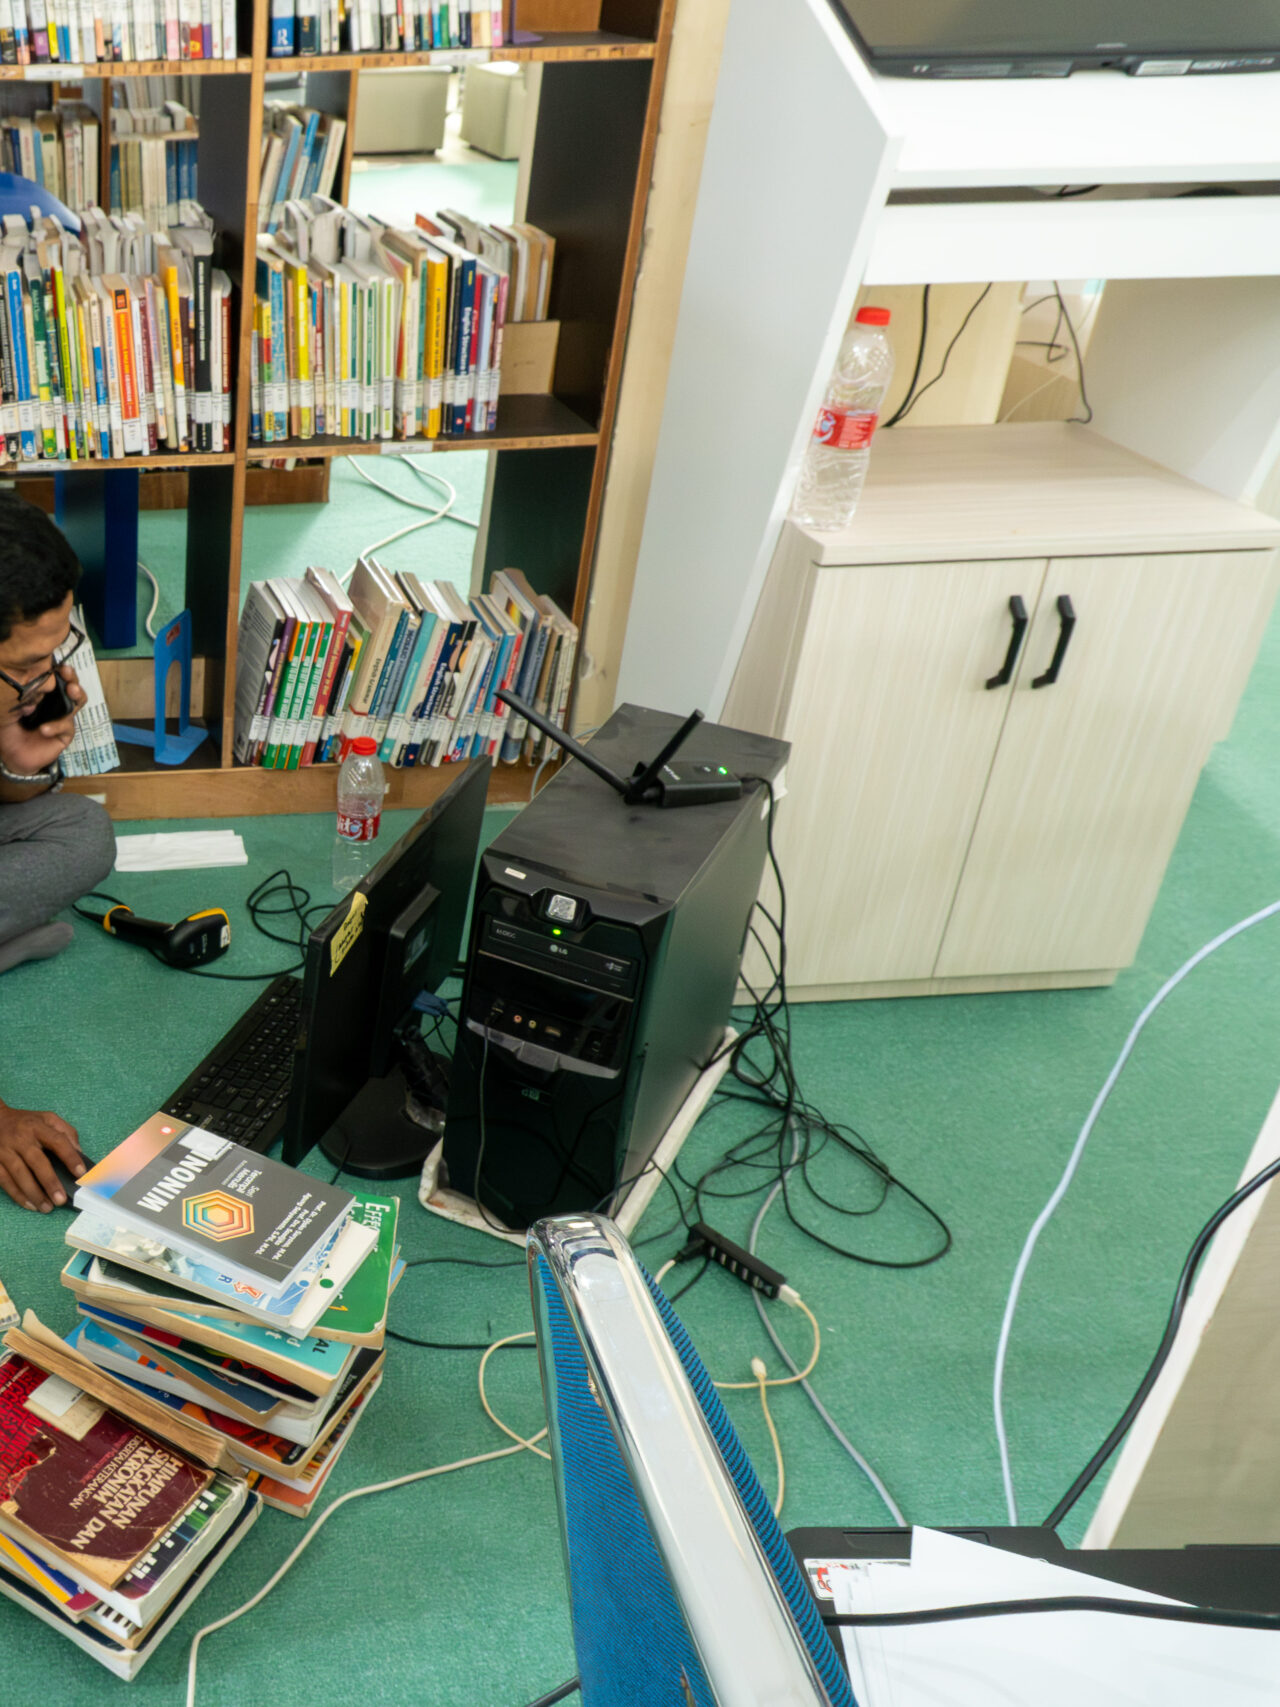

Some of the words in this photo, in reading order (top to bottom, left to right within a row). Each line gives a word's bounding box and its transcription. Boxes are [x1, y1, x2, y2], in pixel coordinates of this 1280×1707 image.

[461, 306, 472, 334] English
[459, 335, 470, 371] Structure
[371, 657, 382, 679] English
[432, 661, 448, 687] English
[362, 678, 376, 705] Grammar
[423, 686, 440, 715] Structure
[135, 1149, 215, 1214] INONIM
[225, 1167, 251, 1189] Menulis
[233, 1168, 263, 1193] Terampil
[243, 1184, 260, 1197] Seri
[111, 1433, 144, 1465] DISERTAI
[67, 1458, 119, 1511] KETERANGAN
[90, 1438, 157, 1506] AKRONIM
[96, 1446, 171, 1523] SINGKATAN
[109, 1454, 184, 1533] HIMPUNAN
[68, 1514, 105, 1551] DAN
